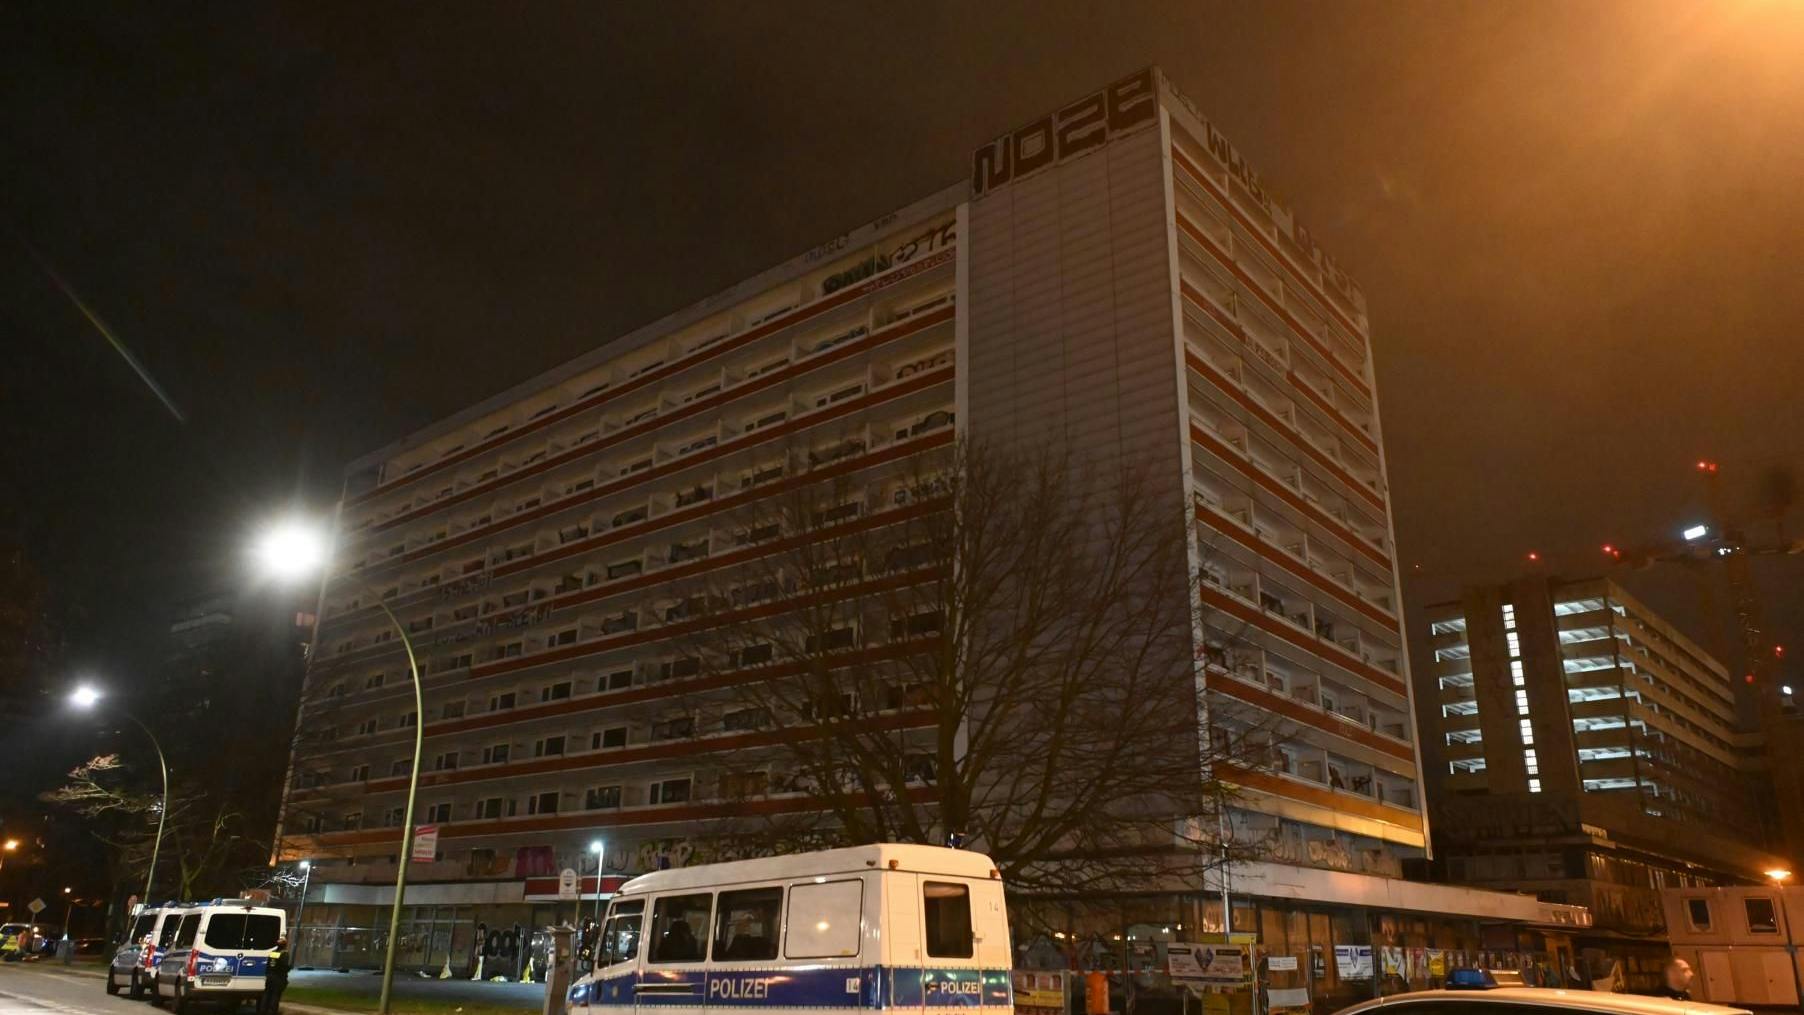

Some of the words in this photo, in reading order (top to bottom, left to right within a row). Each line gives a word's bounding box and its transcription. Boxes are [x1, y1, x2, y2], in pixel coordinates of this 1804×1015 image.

[199, 964, 235, 974] POEI
[710, 977, 769, 999] POLIZEI
[940, 981, 981, 994] POLIZEI
